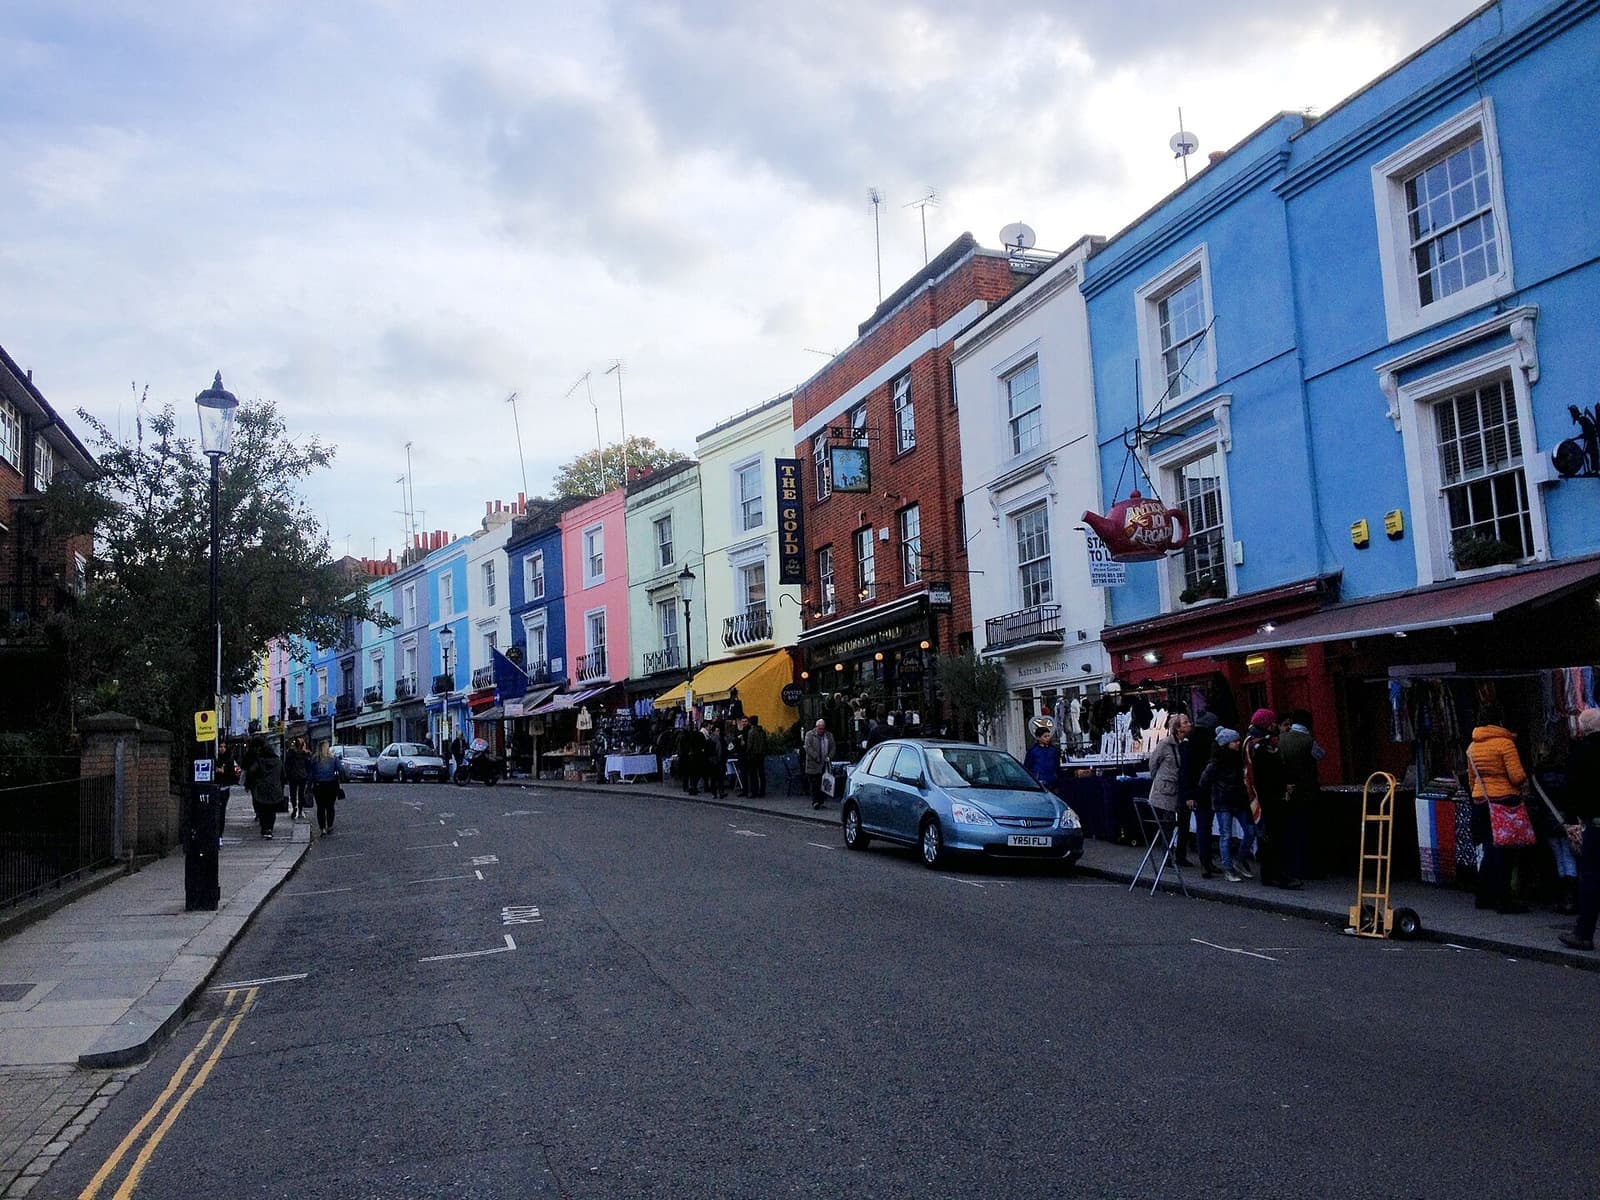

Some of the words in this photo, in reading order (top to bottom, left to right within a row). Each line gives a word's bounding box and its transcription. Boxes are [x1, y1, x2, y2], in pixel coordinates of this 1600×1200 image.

[781, 465, 797, 500] THE
[783, 508, 799, 555] GOLD
[1089, 550, 1103, 562] TO
[1012, 836, 1031, 845] YR51
[1032, 837, 1048, 846] FLJ
